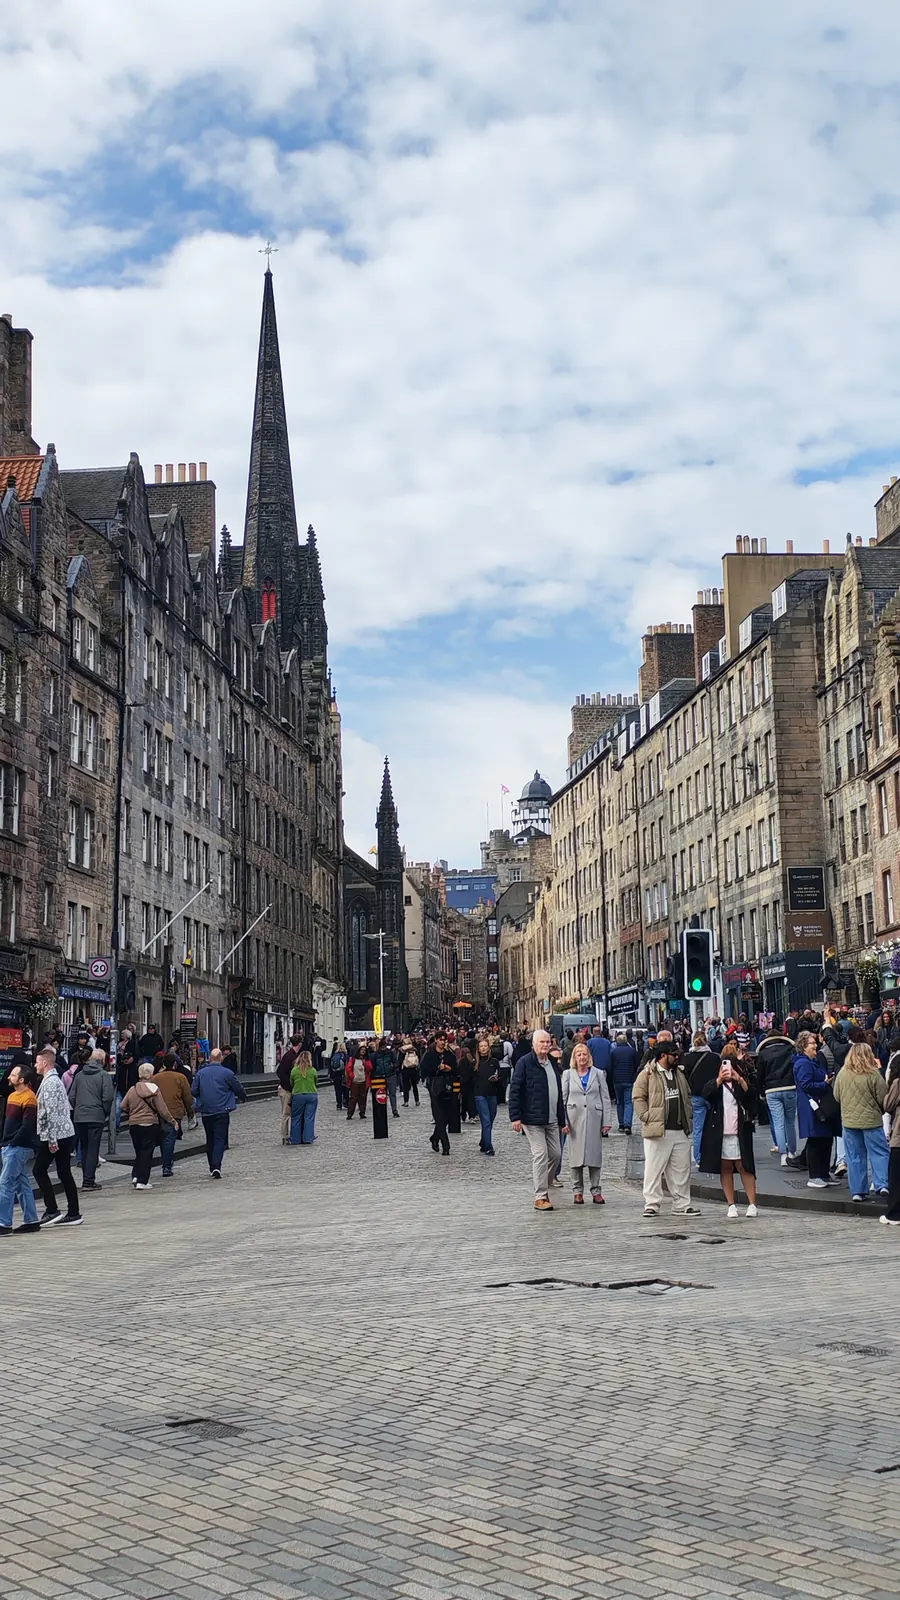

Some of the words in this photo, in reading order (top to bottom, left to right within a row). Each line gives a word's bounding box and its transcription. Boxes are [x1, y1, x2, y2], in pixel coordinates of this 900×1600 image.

[62, 987, 74, 997] ROYAL
[75, 988, 84, 998] MILE
[84, 990, 99, 1000] FACTORY
[338, 997, 344, 1005] K
